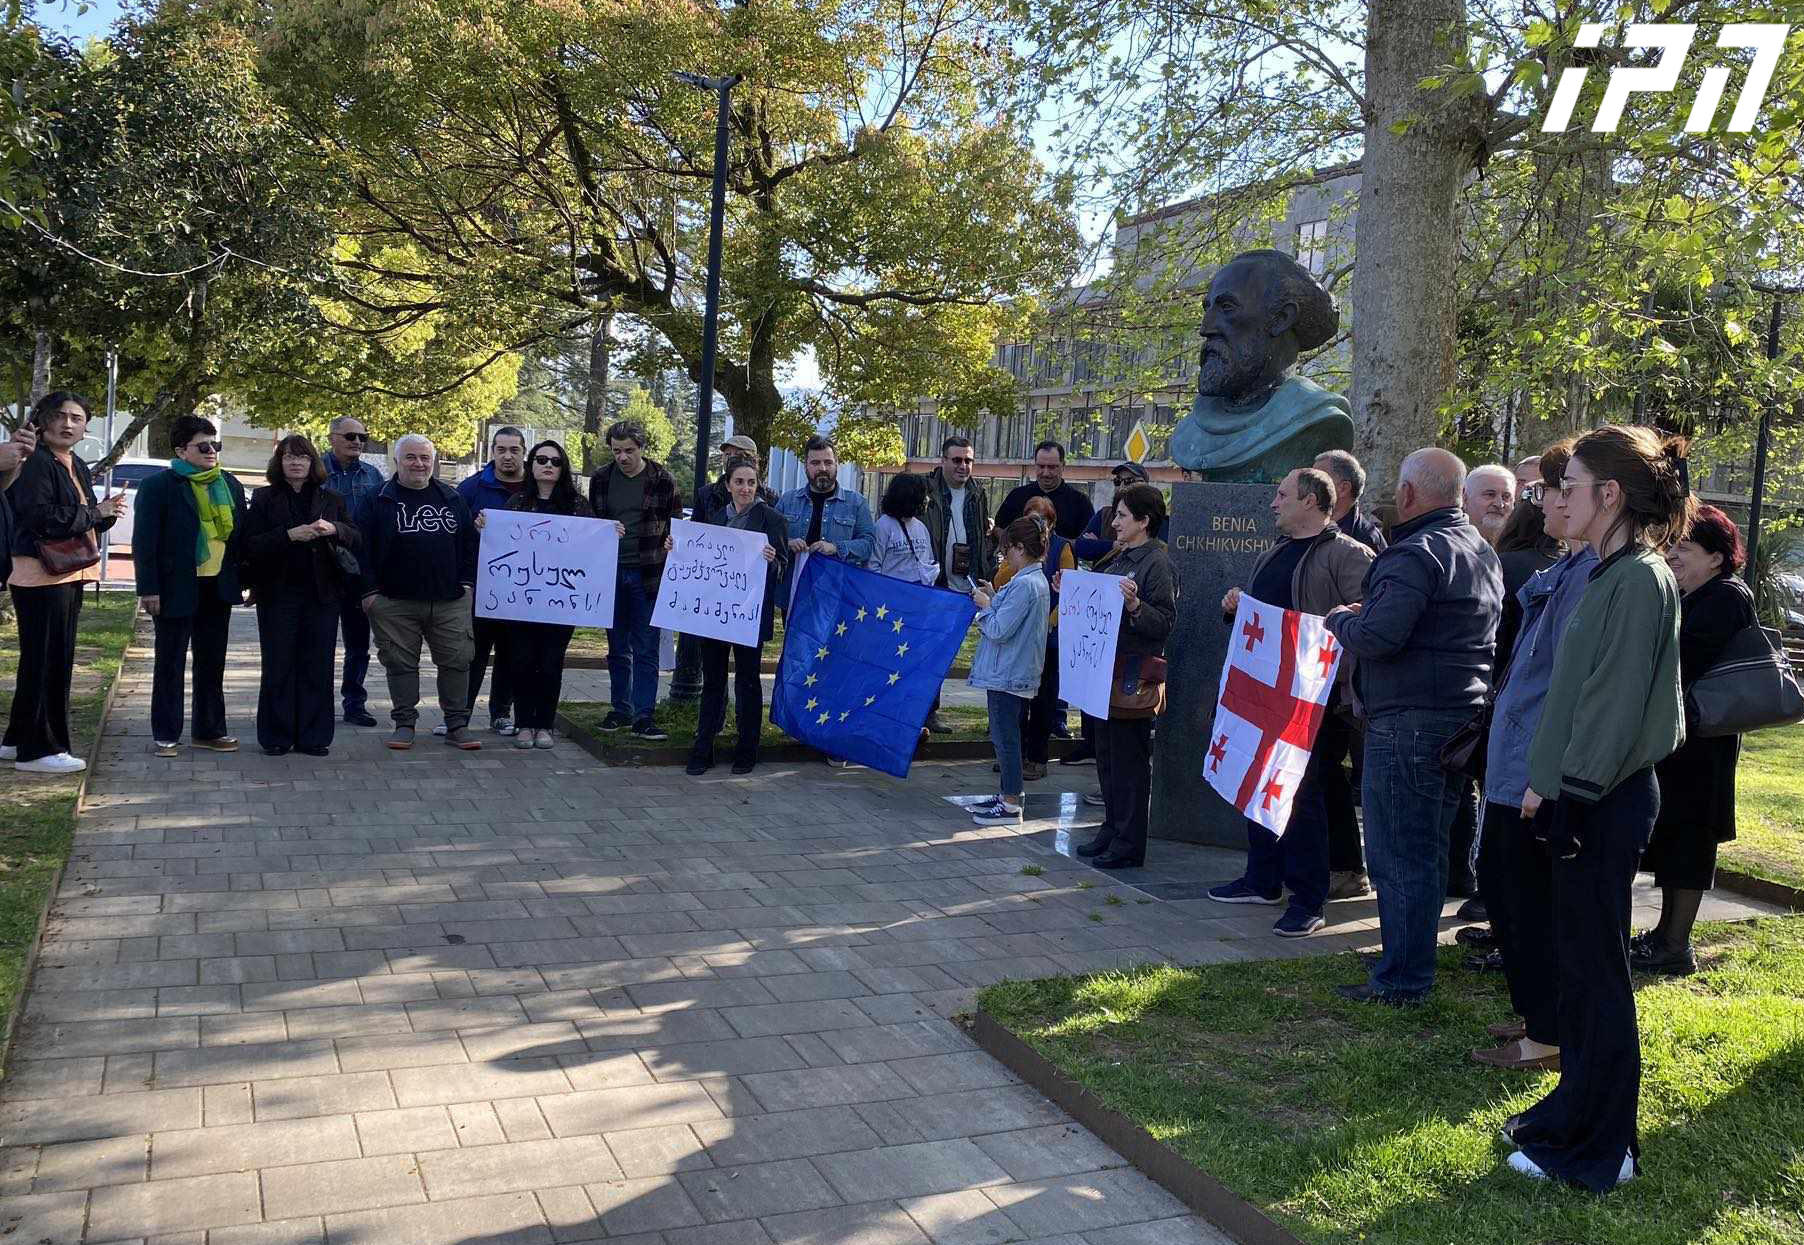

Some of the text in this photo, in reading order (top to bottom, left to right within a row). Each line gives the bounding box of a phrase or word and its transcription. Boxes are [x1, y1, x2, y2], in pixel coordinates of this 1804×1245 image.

[397, 502, 458, 534] Lee
[1212, 516, 1257, 532] BENIA
[510, 520, 570, 544] არა
[1176, 535, 1275, 553] CHKHIKVISHV
[687, 532, 735, 560] ირაკლი
[488, 550, 586, 590] რუსულ
[485, 589, 601, 614] კანონს!
